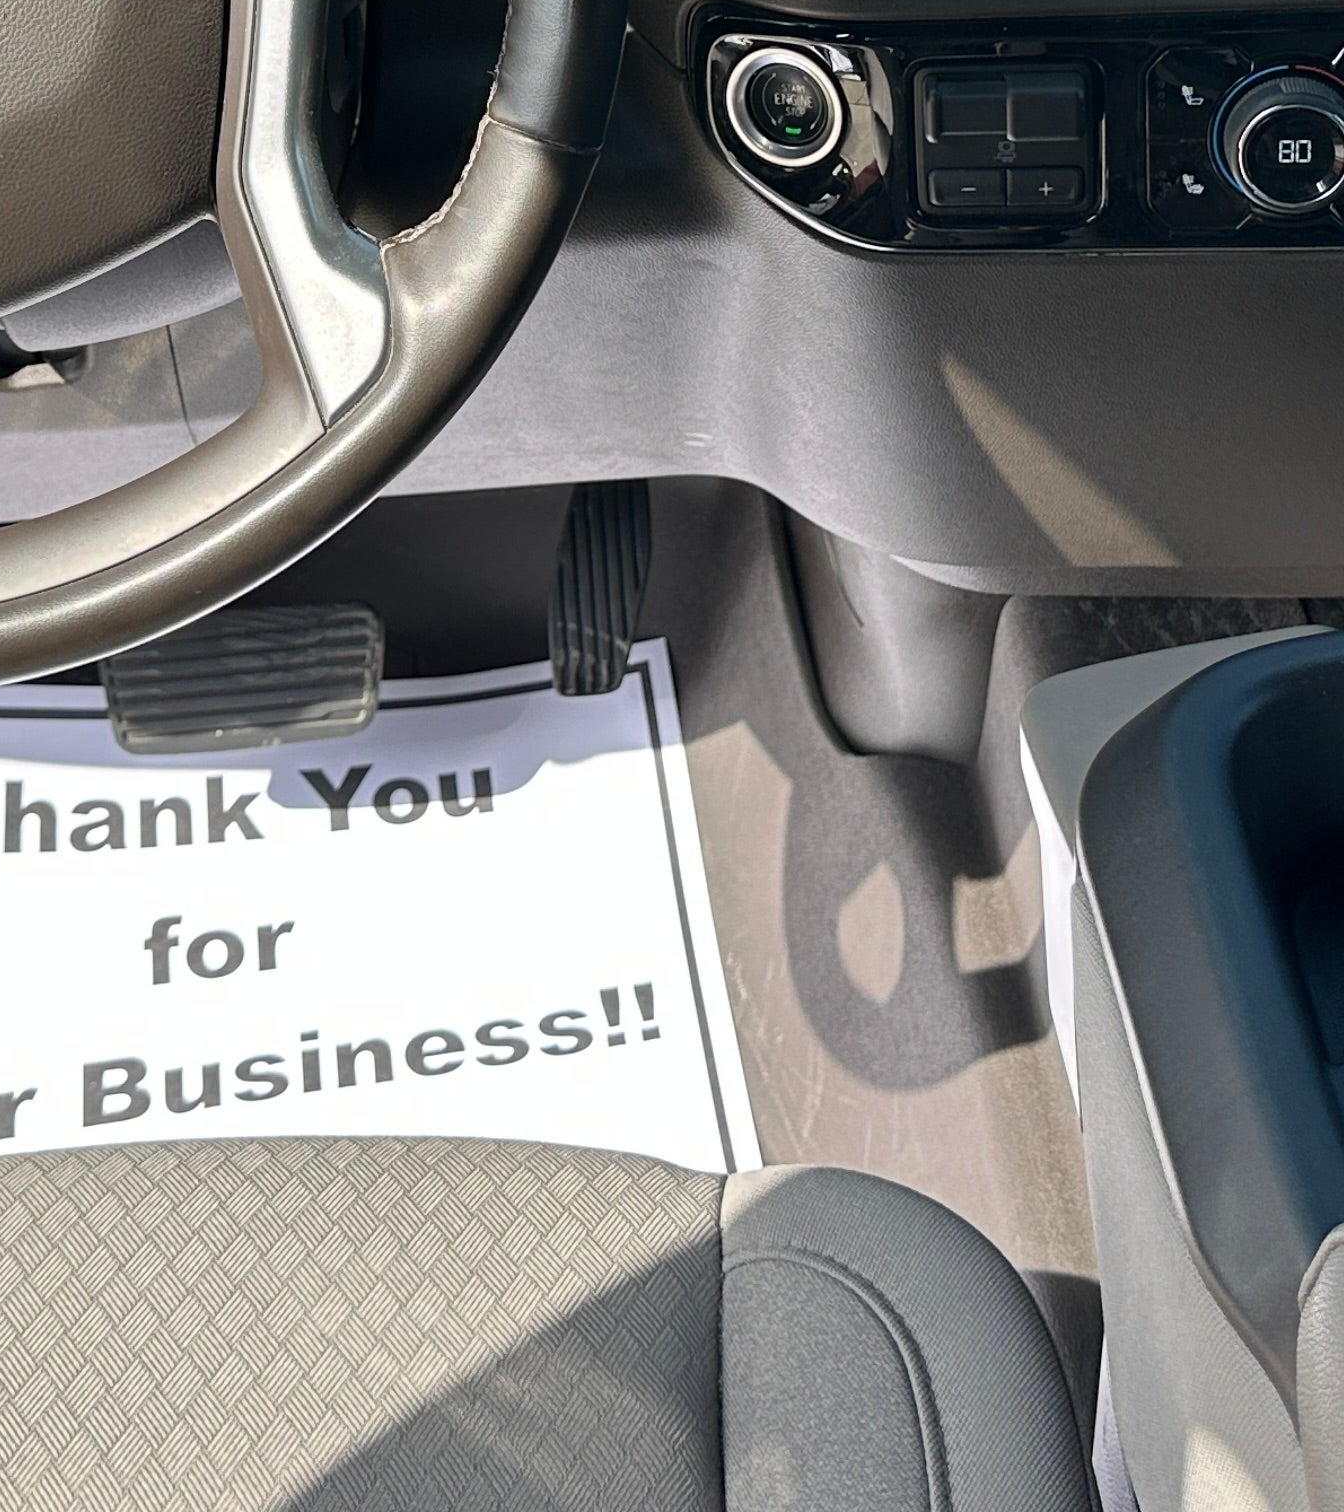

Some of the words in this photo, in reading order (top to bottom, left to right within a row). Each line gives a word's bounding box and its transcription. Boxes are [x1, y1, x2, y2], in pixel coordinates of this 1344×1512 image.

[773, 92, 814, 109] ENGINE
[1278, 139, 1312, 164] 80
[299, 761, 496, 833] You
[142, 913, 296, 988] for
[82, 980, 662, 1129] Business!!
